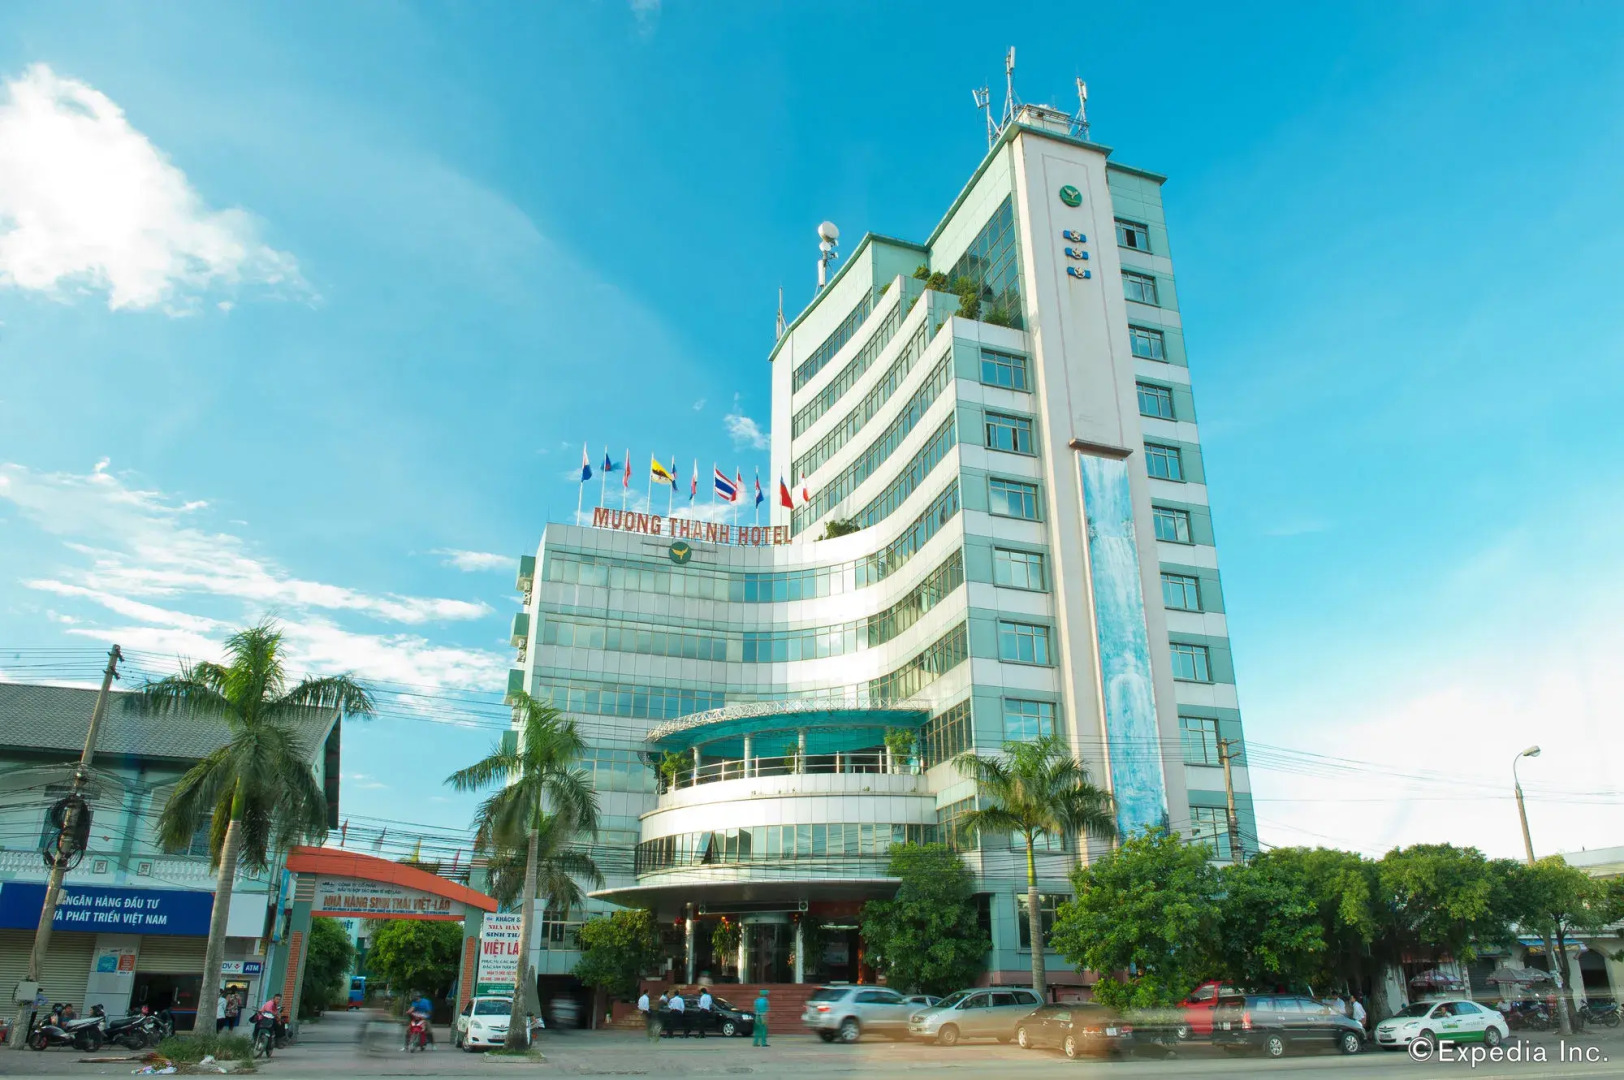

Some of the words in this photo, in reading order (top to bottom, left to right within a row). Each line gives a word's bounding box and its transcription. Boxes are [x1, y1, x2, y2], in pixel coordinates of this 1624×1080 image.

[593, 507, 661, 535] MUONG
[669, 517, 730, 544] THANH
[738, 525, 792, 546] HOTEL
[65, 895, 92, 906] NGÂN
[95, 896, 121, 908] HÀNG
[124, 896, 144, 908] ĐẦU
[146, 898, 160, 909] TƯ
[344, 896, 368, 908] HÀNG
[66, 910, 91, 922] PHÁT
[93, 910, 120, 922] TRIỂN
[123, 912, 144, 925] VIỆT
[145, 914, 168, 924] NAM
[484, 938, 505, 958] VIỆT
[507, 940, 520, 955] LÀ
